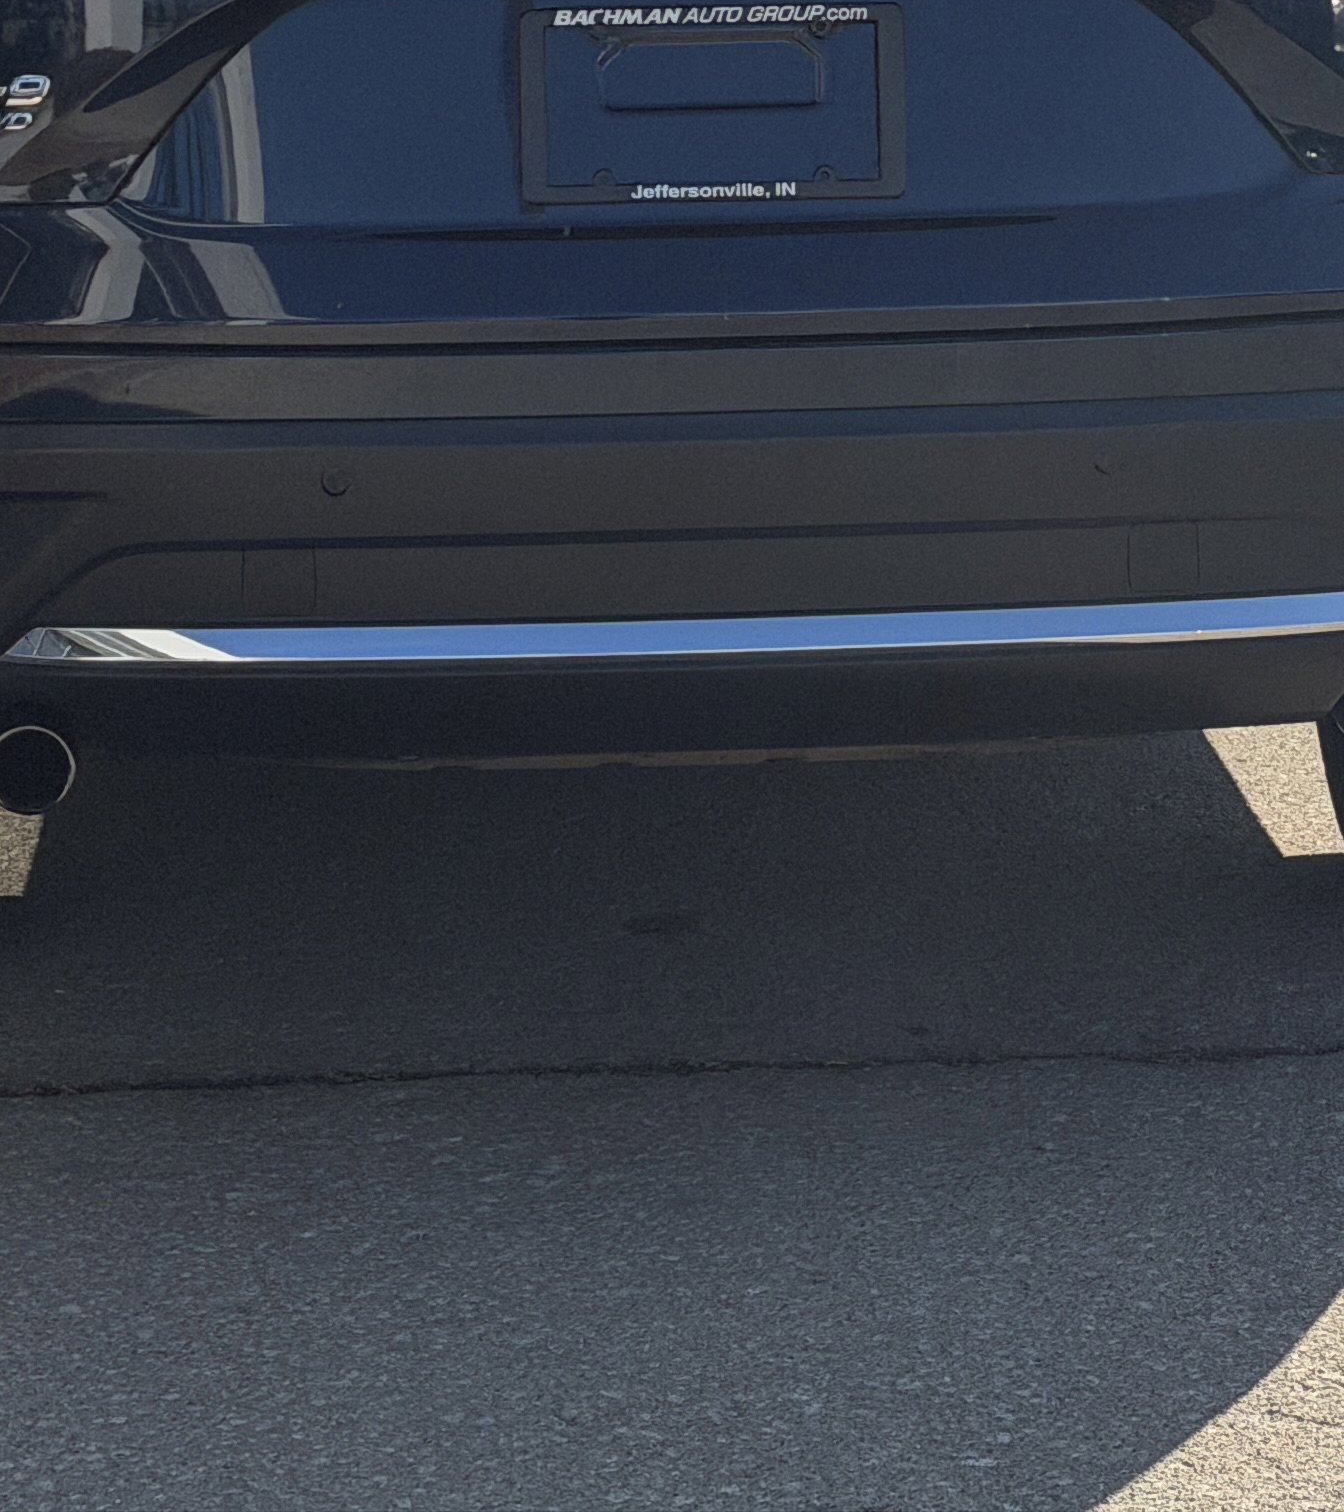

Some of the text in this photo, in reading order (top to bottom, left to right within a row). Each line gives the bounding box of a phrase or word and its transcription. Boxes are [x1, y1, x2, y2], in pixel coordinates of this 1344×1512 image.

[682, 6, 743, 24] AUTO
[747, 4, 868, 22] GROUP.com
[631, 181, 797, 199] Jeffersonville, IN
